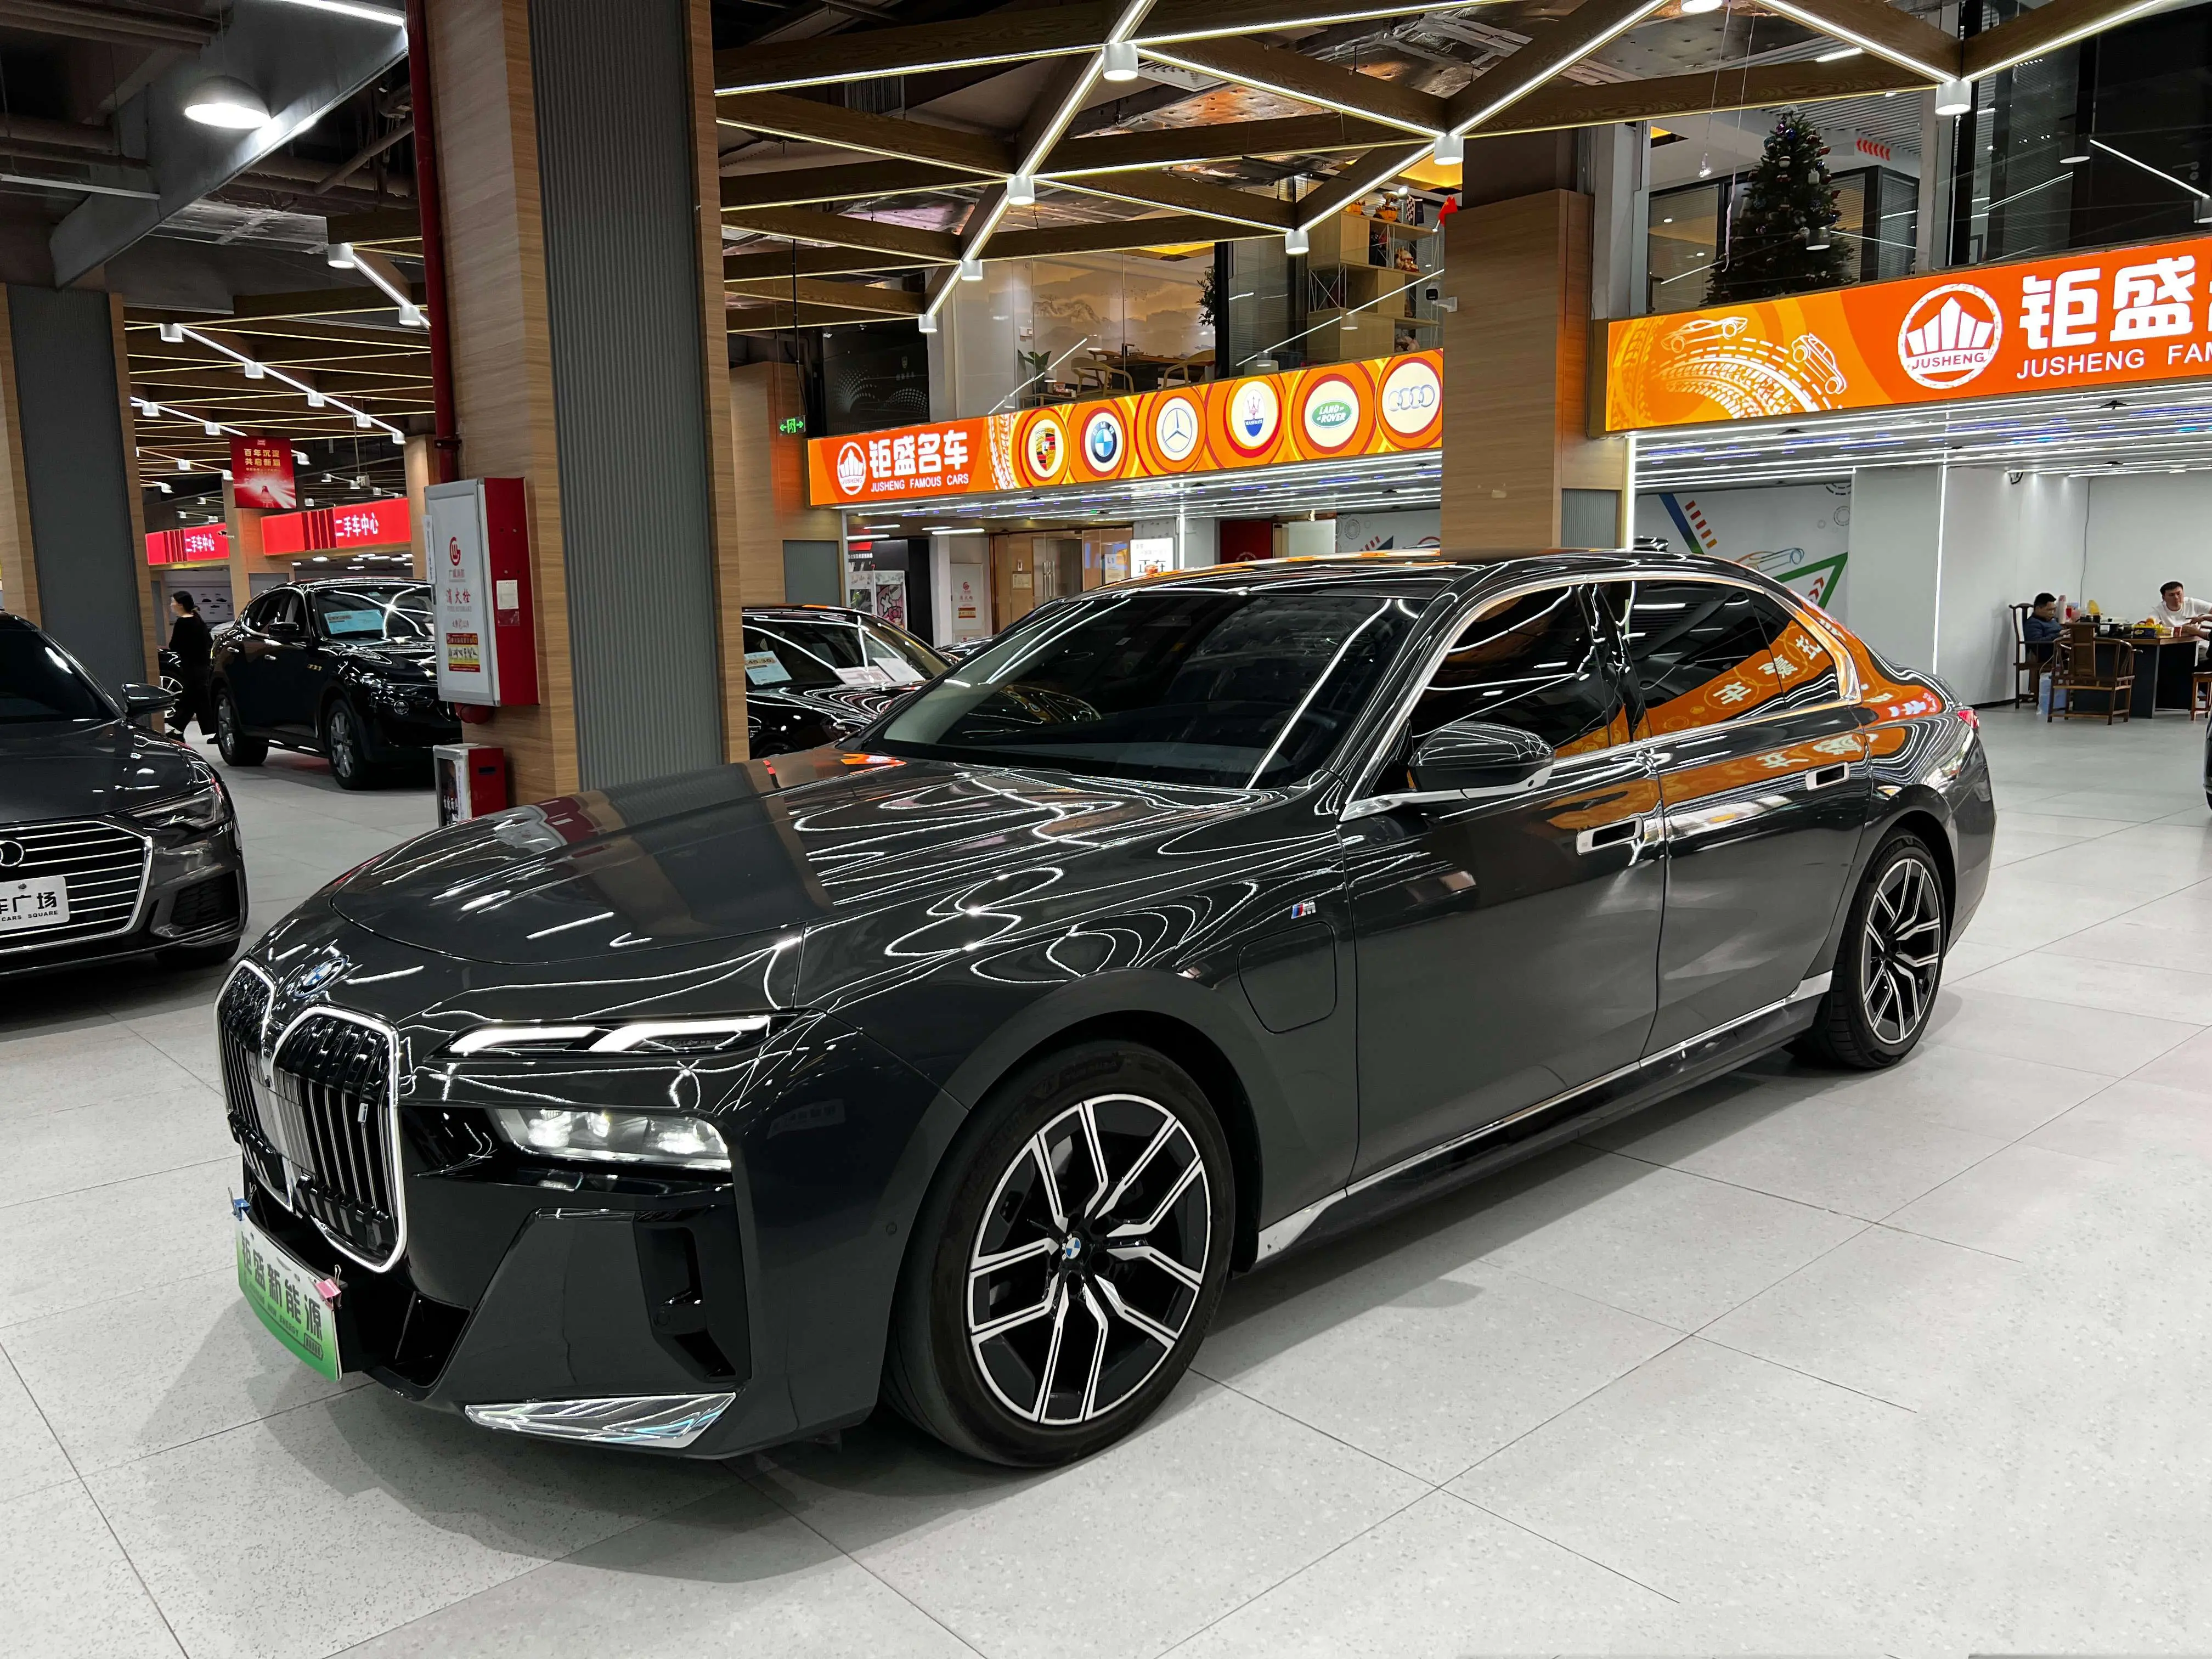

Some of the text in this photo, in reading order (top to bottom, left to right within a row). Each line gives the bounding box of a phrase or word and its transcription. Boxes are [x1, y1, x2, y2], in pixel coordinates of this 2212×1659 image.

[2019, 255, 2212, 349] 钜盛
[1912, 352, 1985, 370] JUSHENG
[2016, 349, 2145, 379] JUSHENG
[1319, 405, 1340, 415] LAND
[1321, 413, 1346, 423] ROVER
[1092, 421, 1115, 436] BMW
[244, 448, 280, 458] 百年沉淀
[869, 430, 968, 478] 钜盛名车
[871, 473, 969, 492] JUSHENG FAMOUS CARS
[335, 512, 379, 538] 二手车中心
[185, 533, 215, 553] 二手车中心
[28, 910, 59, 918] SQUARE
[241, 1231, 323, 1341] 钜盛新能源
